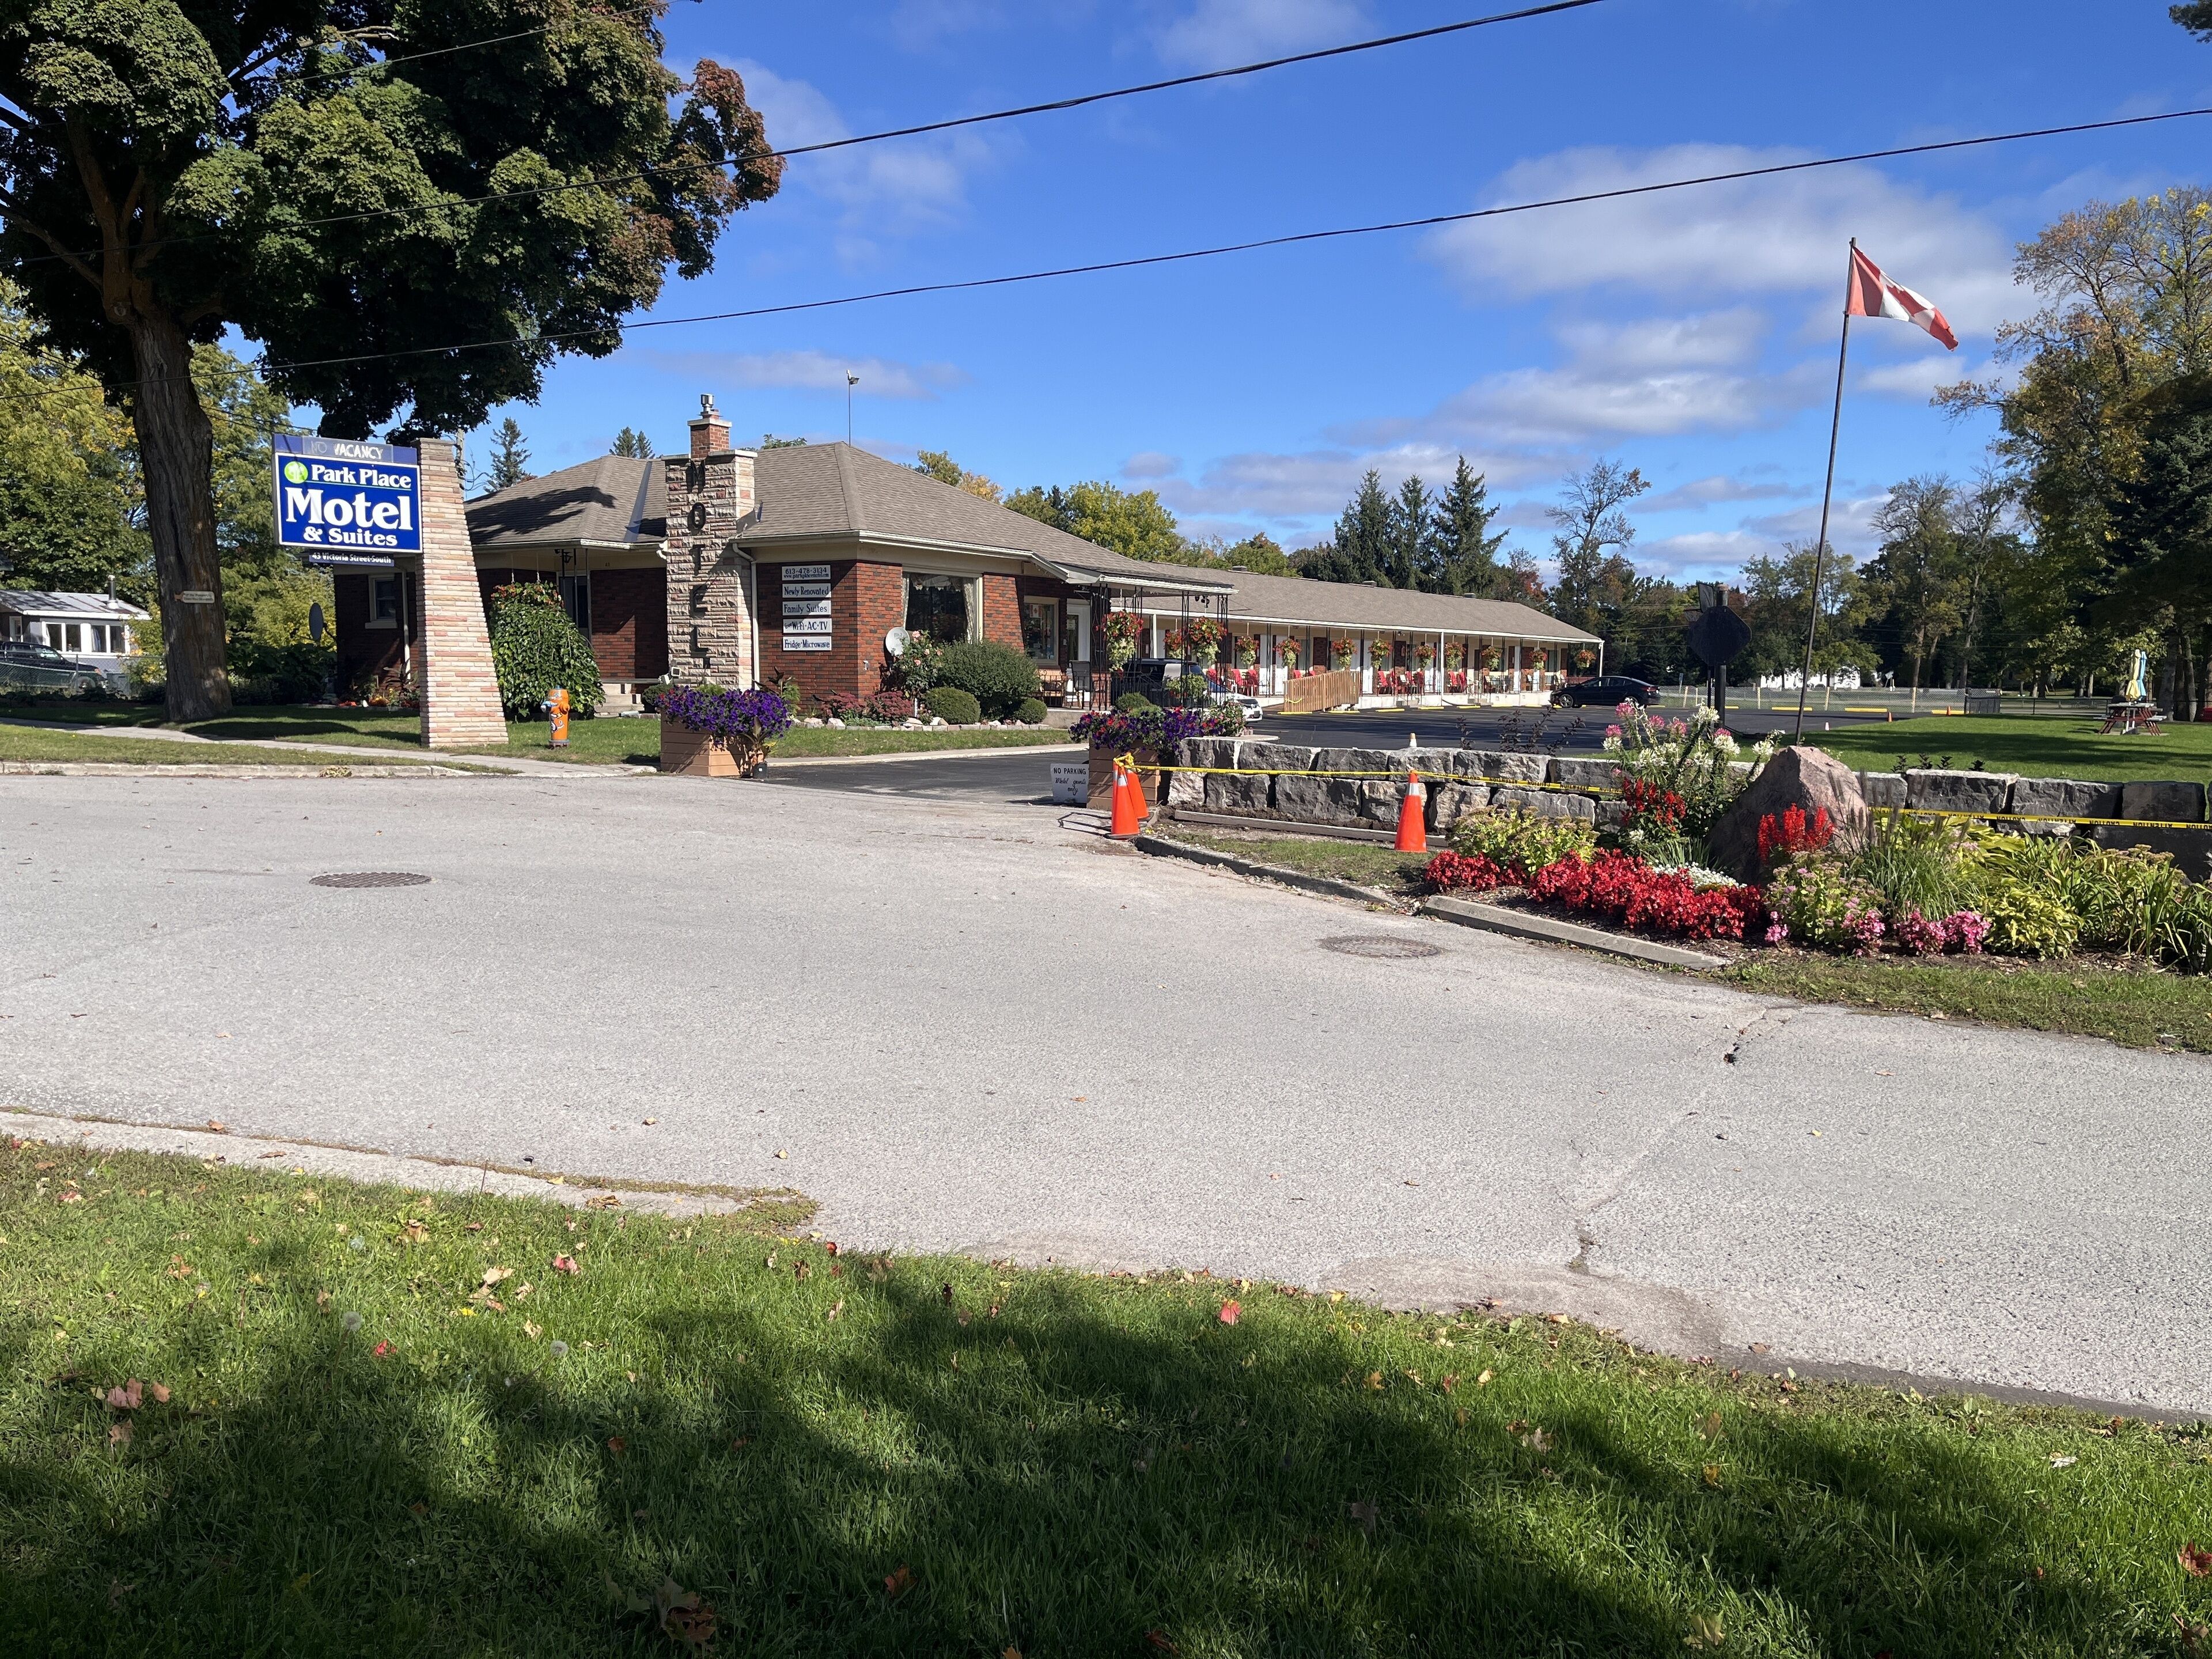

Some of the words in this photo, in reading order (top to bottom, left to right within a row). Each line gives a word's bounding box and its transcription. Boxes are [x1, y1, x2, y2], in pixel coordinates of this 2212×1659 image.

[334, 443, 384, 460] VACANCY
[311, 464, 357, 484] Park
[359, 468, 411, 488] Place
[285, 487, 413, 531] Motel
[303, 526, 323, 542] &
[328, 527, 398, 547] Suites
[322, 552, 349, 561] Victoria
[690, 460, 709, 652] MOTEL
[784, 586, 800, 596] Newly
[800, 586, 829, 595] Renovated
[784, 604, 804, 614] Family
[806, 603, 827, 612] Suites
[819, 621, 828, 630] TV
[784, 639, 801, 649] Fridge
[802, 639, 830, 648] Microwave
